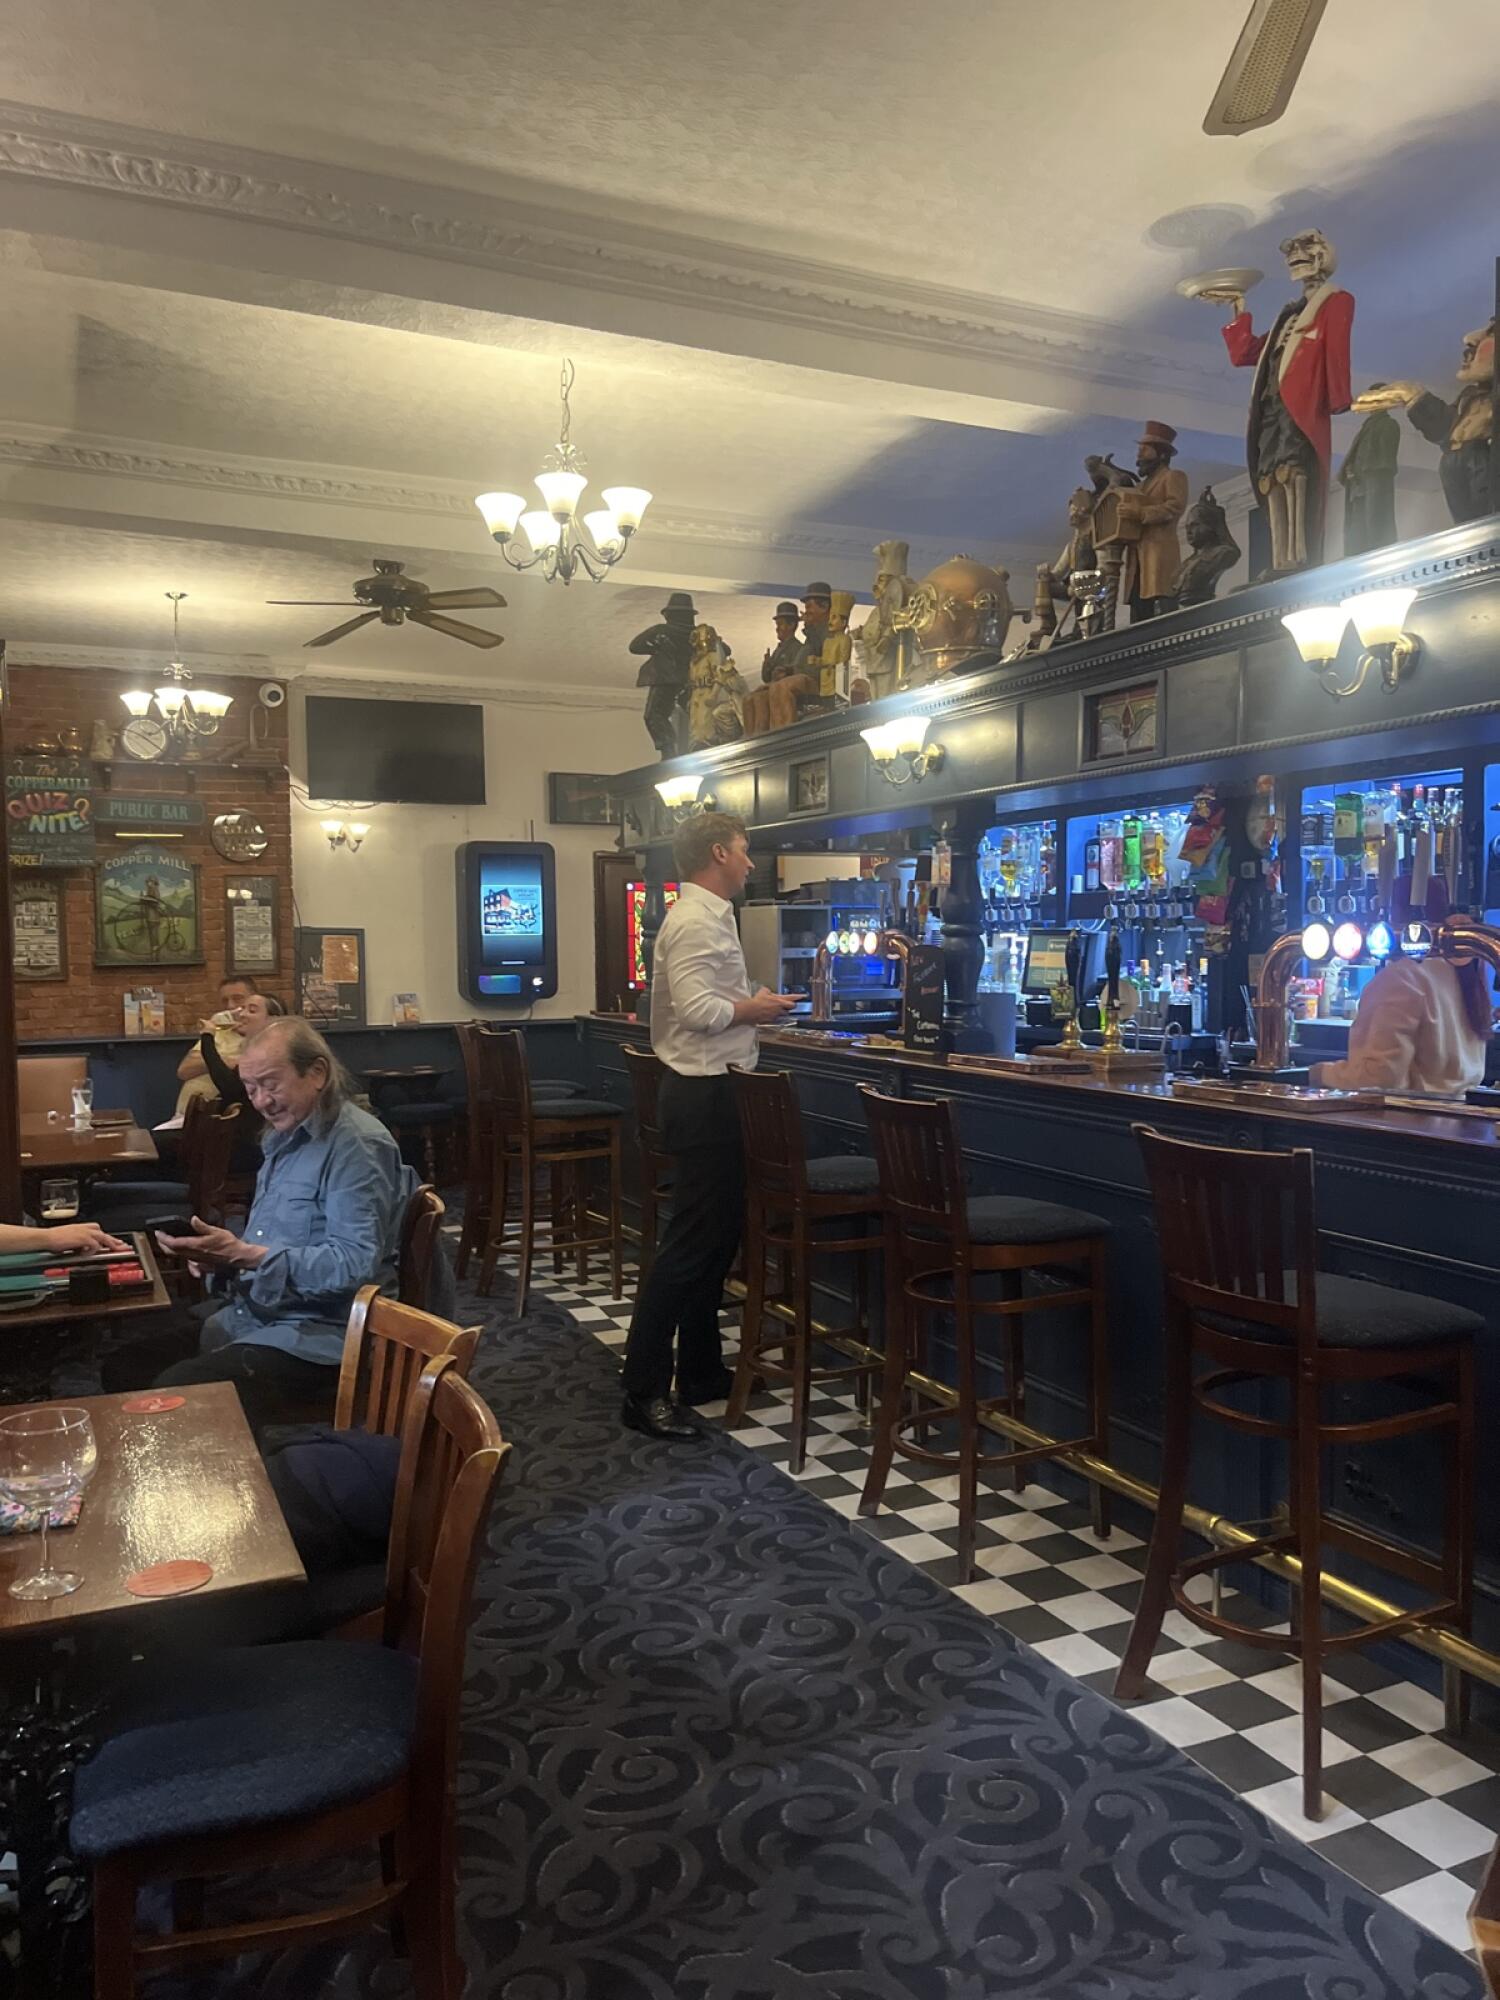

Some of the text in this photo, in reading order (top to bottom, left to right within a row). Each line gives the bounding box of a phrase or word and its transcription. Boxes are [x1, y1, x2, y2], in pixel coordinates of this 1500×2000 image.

[6, 776, 89, 790] COPPERMILL
[8, 792, 68, 818] QUIZ
[110, 802, 188, 819] PUBLIC BAR
[105, 855, 153, 870] COPPER
[159, 856, 190, 872] MILL
